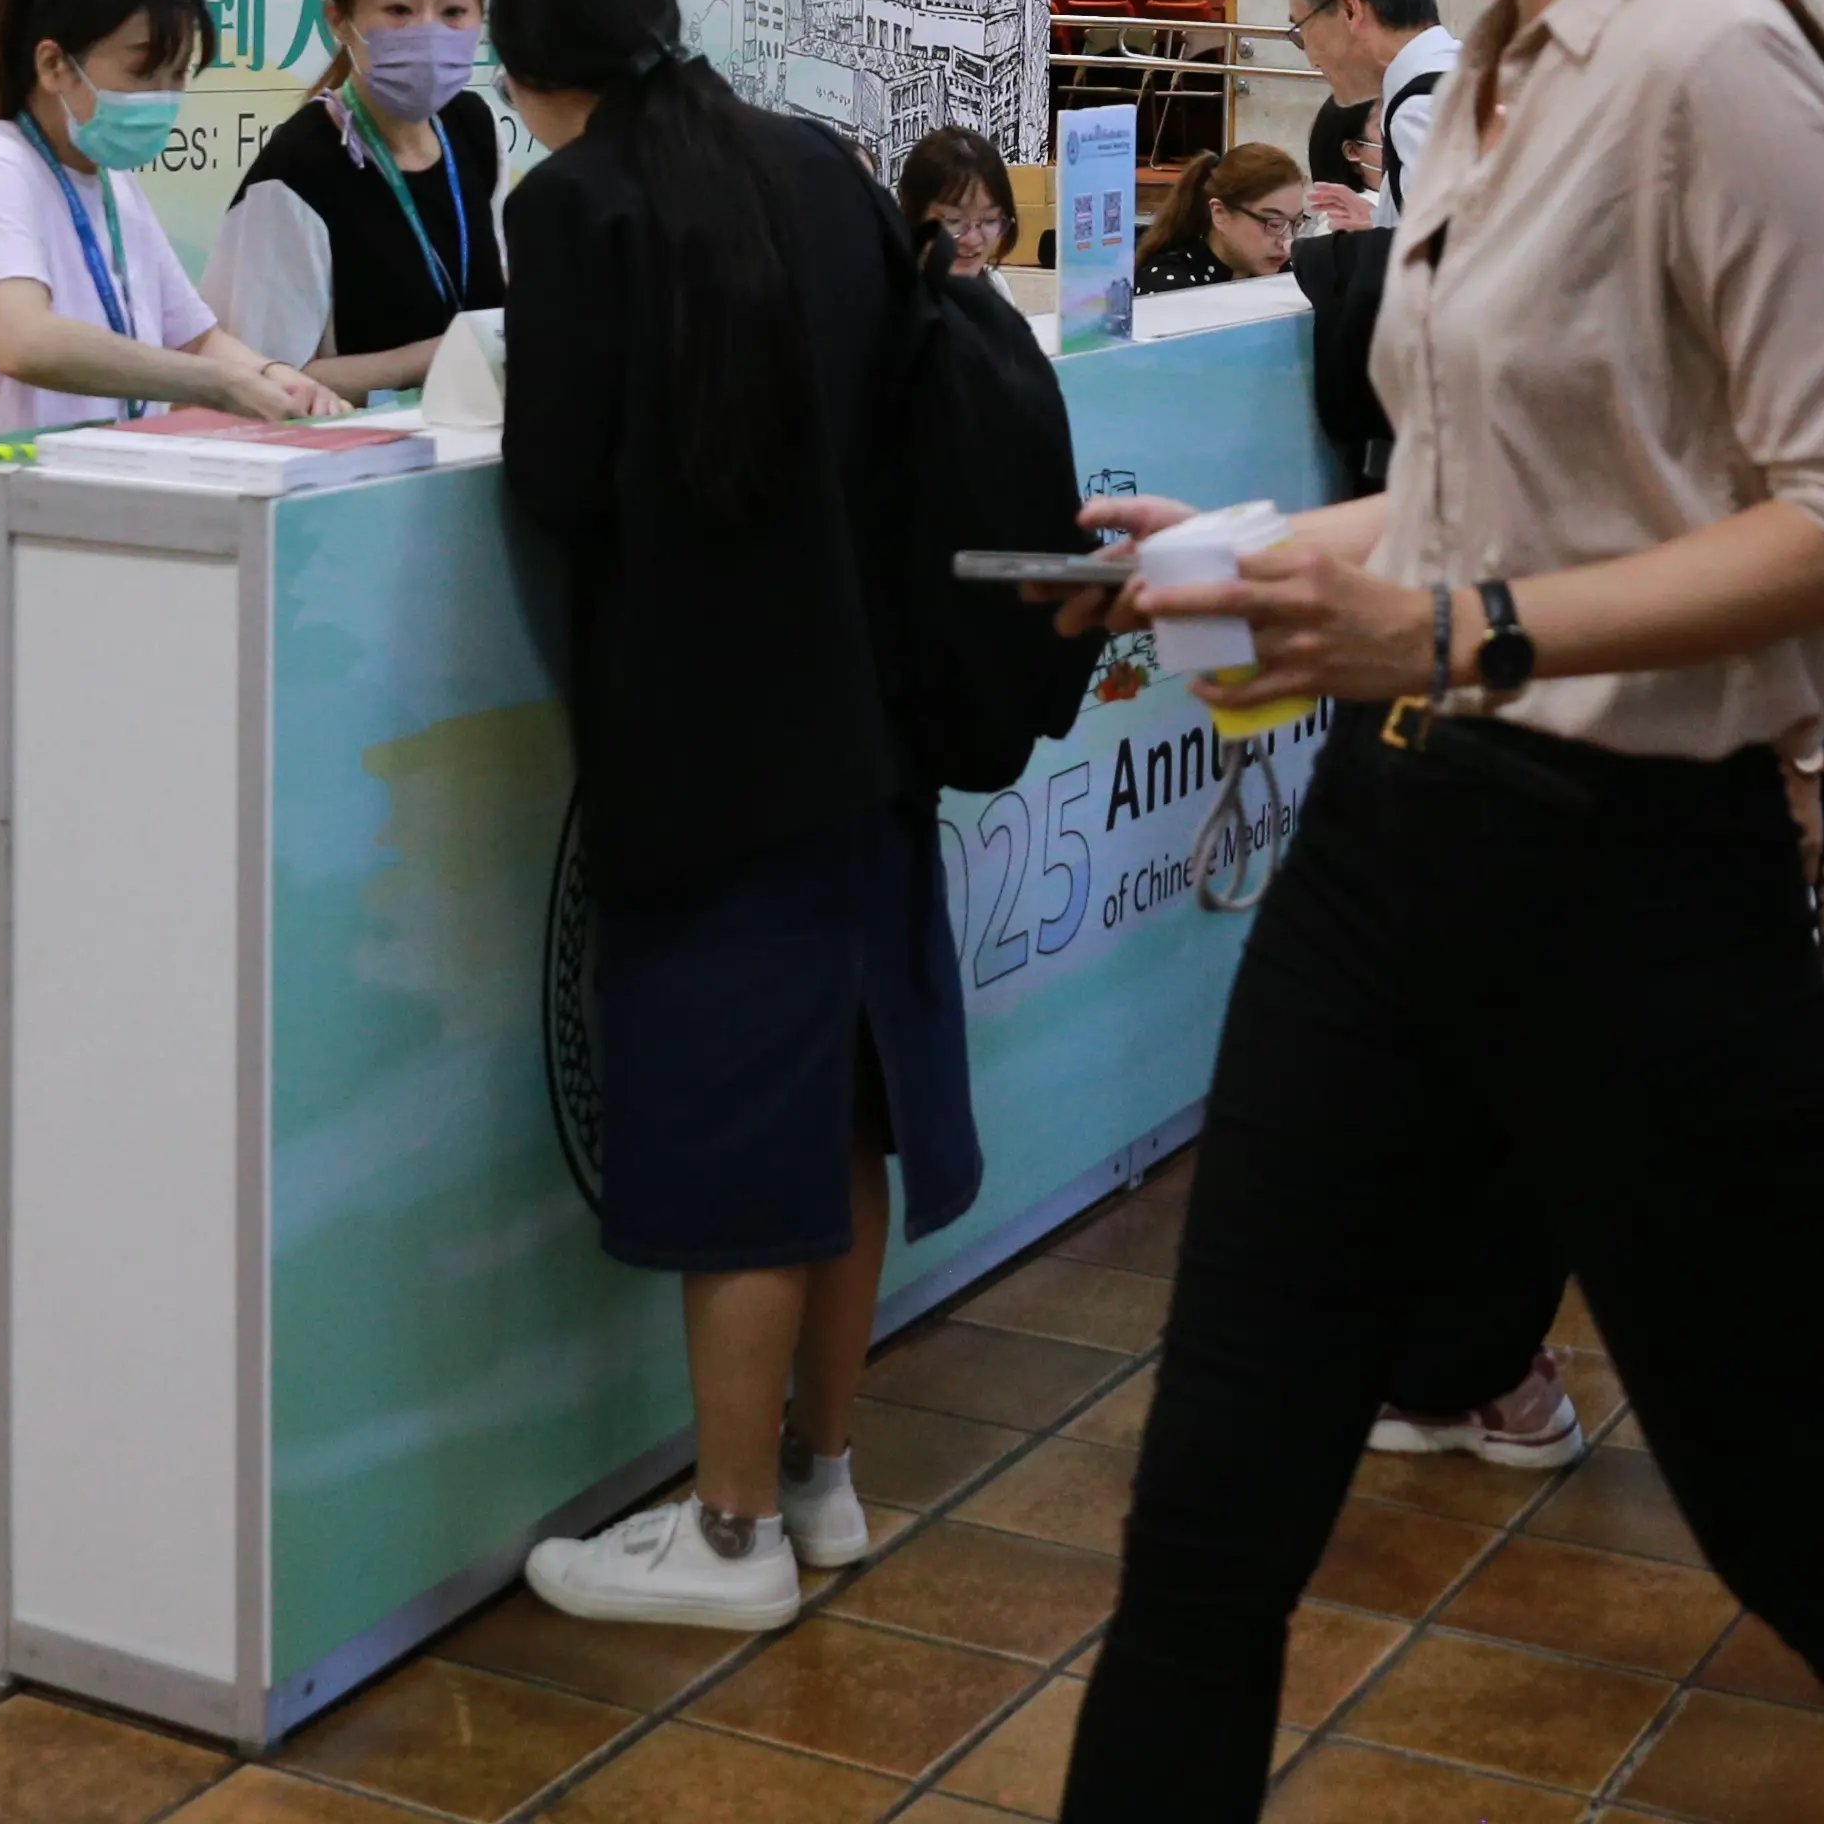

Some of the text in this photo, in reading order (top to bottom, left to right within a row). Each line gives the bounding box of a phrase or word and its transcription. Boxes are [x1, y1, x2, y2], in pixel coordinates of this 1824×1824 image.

[938, 761, 1093, 989] 25
[1103, 788, 1298, 929] of Chinee Medial
